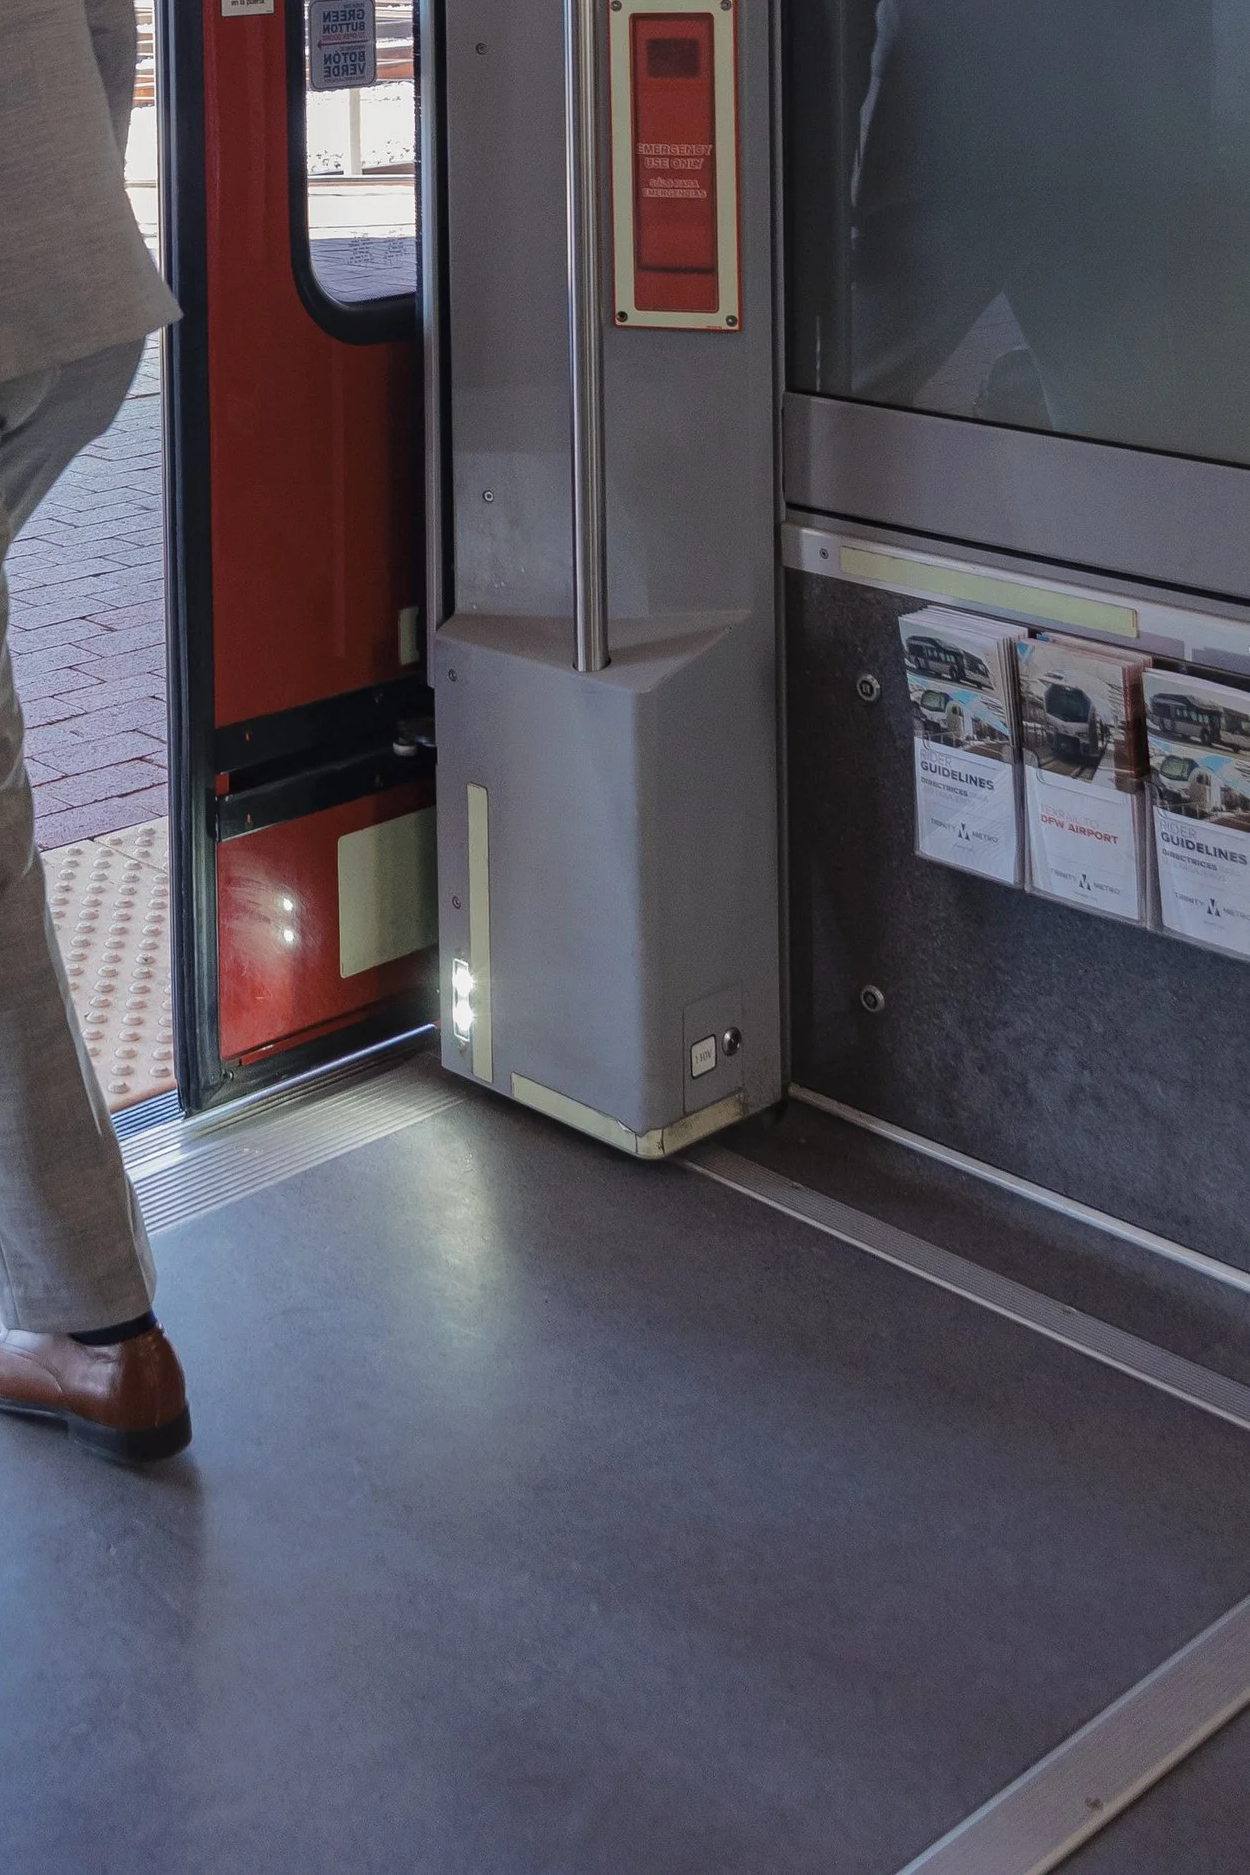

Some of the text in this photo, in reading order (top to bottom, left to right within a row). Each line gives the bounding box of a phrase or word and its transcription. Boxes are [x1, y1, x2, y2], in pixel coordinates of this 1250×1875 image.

[637, 143, 712, 156] EMERGENCY
[644, 157, 704, 170] USE ONLY
[919, 749, 952, 767] RIDER
[920, 760, 995, 791] GUIDELINES
[920, 776, 968, 797] DIRECTRICES
[972, 830, 998, 843] METRO
[1040, 814, 1118, 845] DFW AIRPORT
[1160, 820, 1197, 840] RIDER
[1160, 831, 1248, 865] GUIDELINES
[1161, 848, 1218, 871] DIRECTRICES
[1093, 881, 1120, 895] METRO
